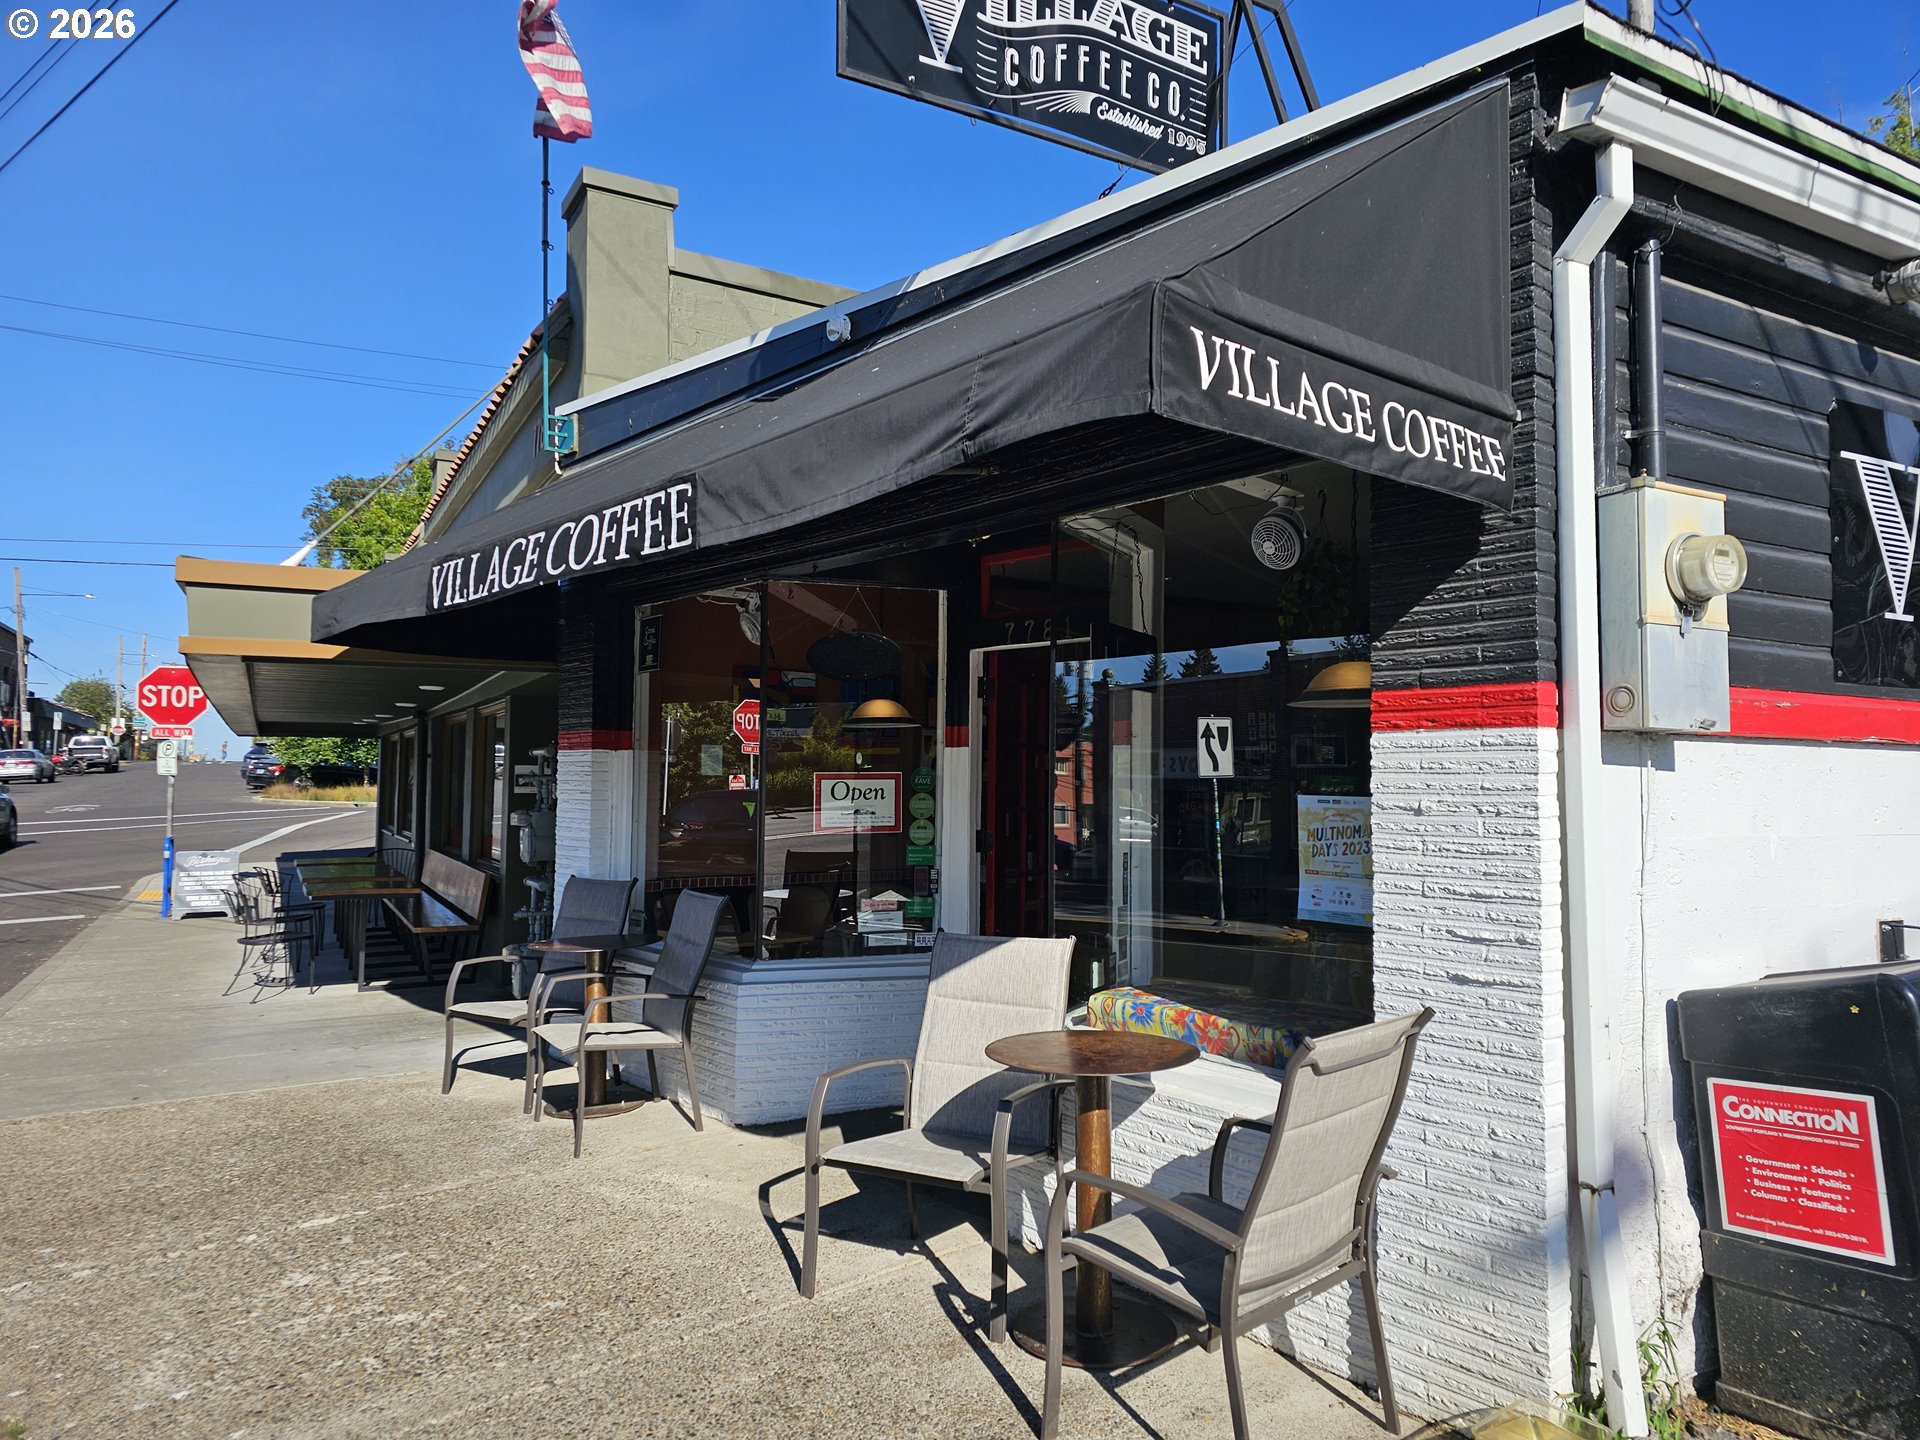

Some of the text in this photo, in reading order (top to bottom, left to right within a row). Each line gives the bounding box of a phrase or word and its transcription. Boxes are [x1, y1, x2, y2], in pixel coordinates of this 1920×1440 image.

[1004, 43, 1185, 121] COFFEE CO.
[1097, 101, 1164, 139] Established
[1190, 326, 1506, 481] VILLAGE COFFEE
[431, 483, 693, 609] VILLAGE COFFEE
[1005, 616, 1072, 644] 7781
[141, 685, 205, 708] STOP
[830, 781, 886, 804] Open
[1312, 840, 1371, 858] DAYS 2023
[1722, 1095, 1859, 1135] CONNECTION
[1753, 1099, 1791, 1108] SOUTHWEST
[1745, 1154, 1848, 1178] Government Schools
[1752, 1166, 1852, 1191] Environment Politics
[1750, 1188, 1848, 1213] Columns Classifieds
[1753, 1178, 1842, 1201] Business Features
